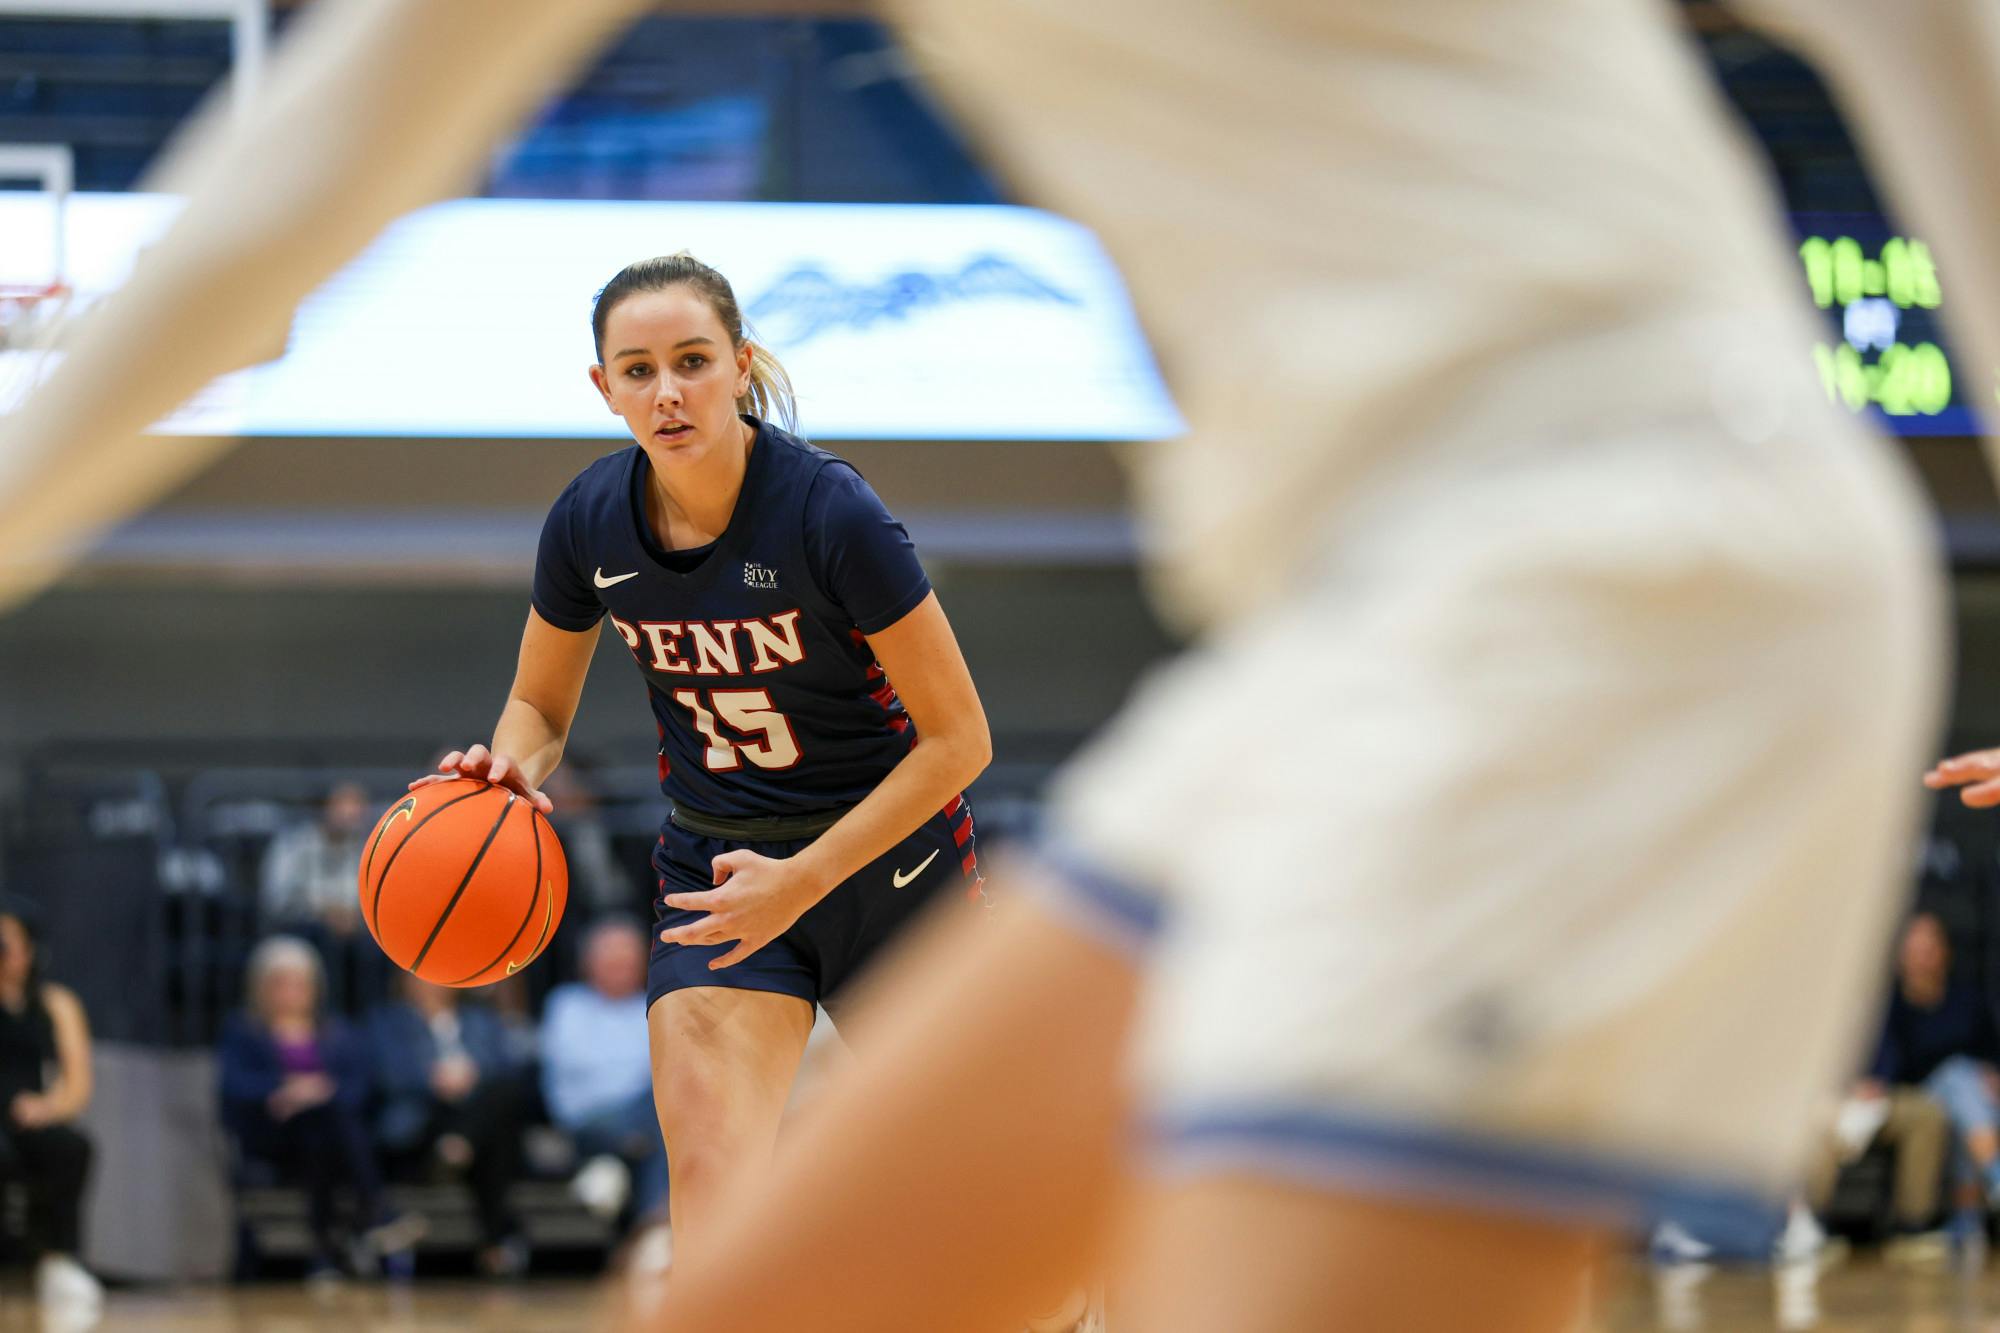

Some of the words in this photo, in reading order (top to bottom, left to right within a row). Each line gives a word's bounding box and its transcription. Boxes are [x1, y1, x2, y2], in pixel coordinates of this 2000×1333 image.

[751, 581, 779, 589] LEAGUE
[752, 568, 777, 582] IVY
[610, 608, 805, 677] PENN
[672, 687, 804, 774] 15
